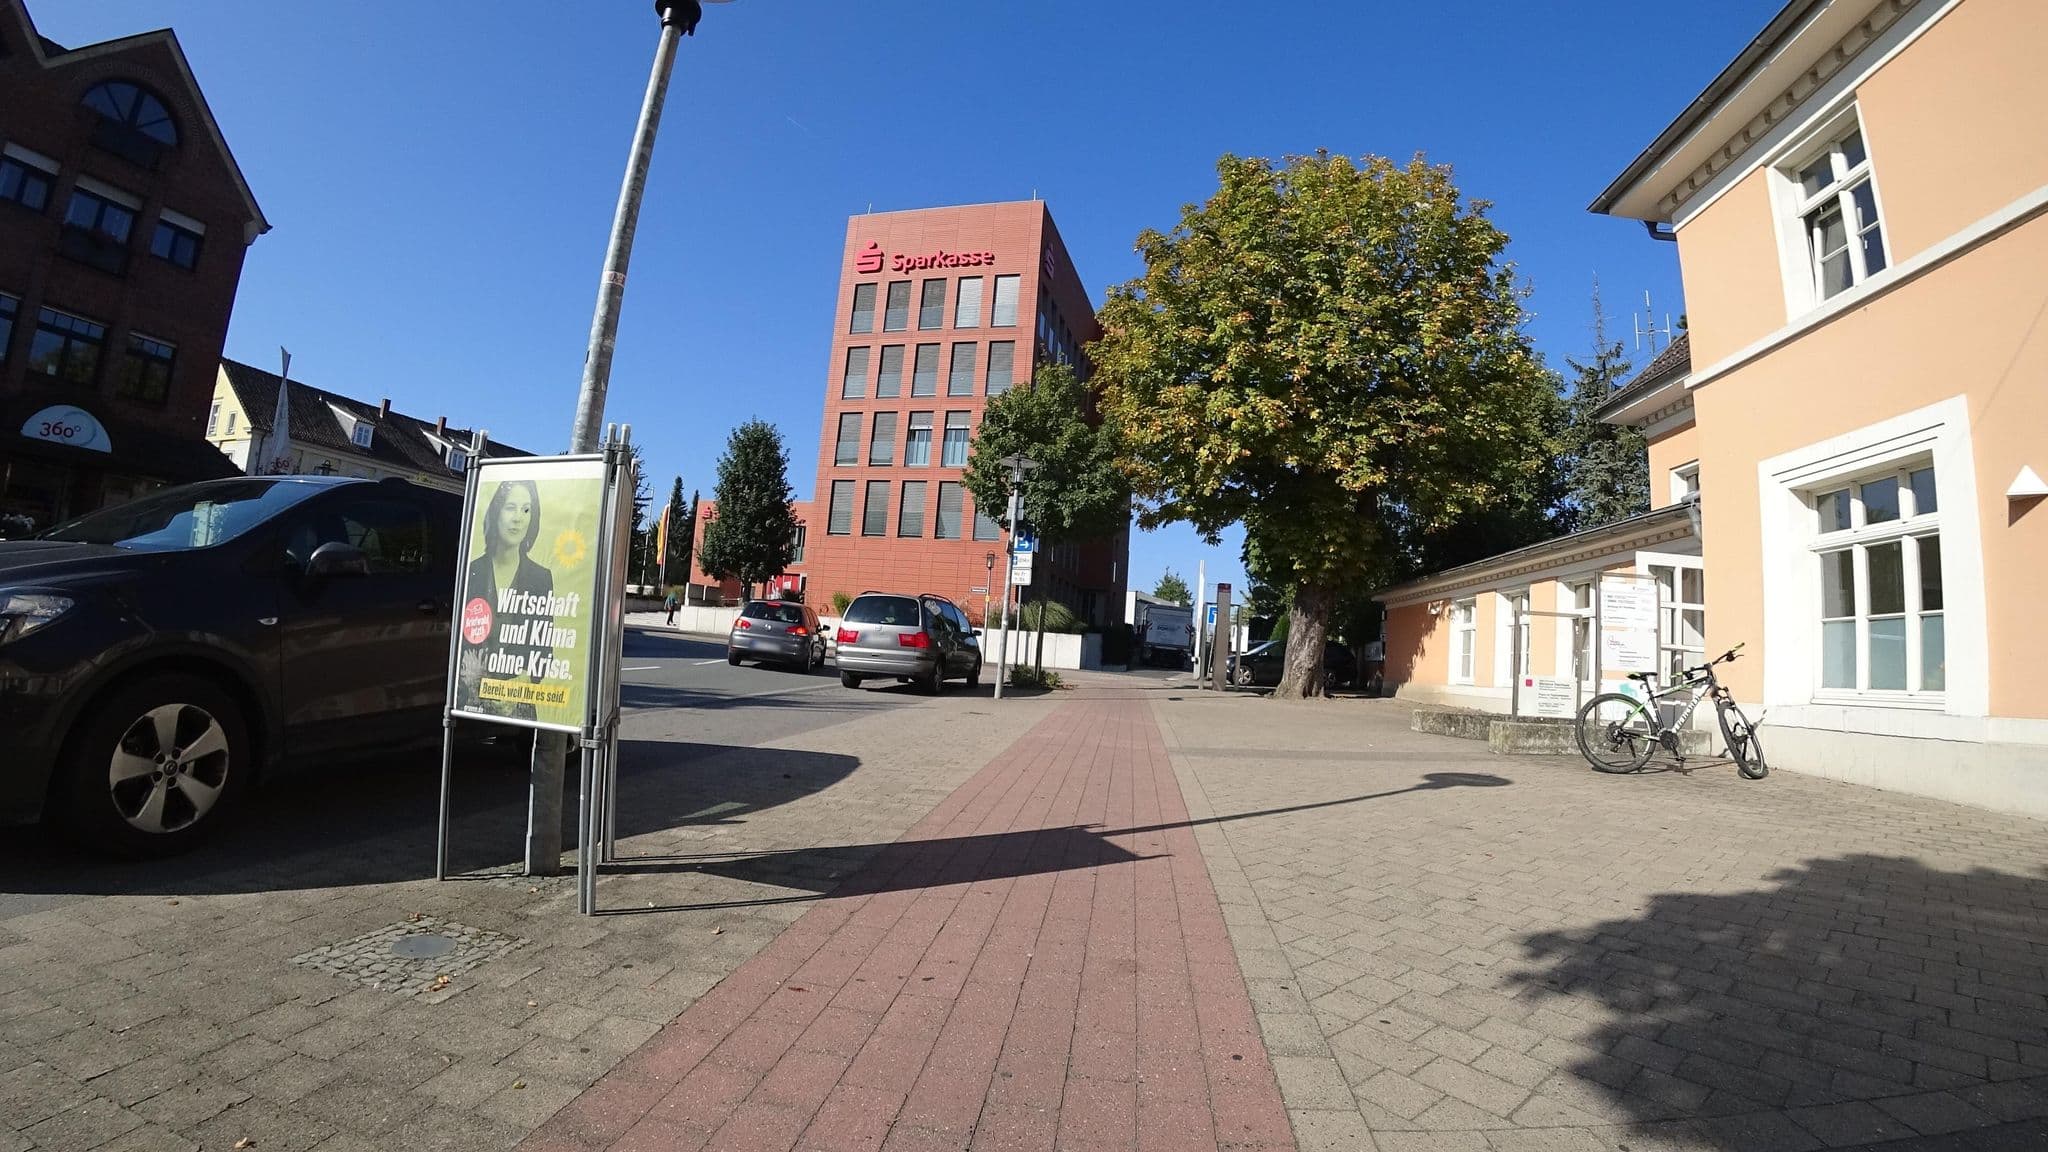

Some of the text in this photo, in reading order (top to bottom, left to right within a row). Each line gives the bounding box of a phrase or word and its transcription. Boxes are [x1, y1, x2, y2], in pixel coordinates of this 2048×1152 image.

[892, 250, 994, 275] Sparkasse
[497, 587, 580, 618] Wirtschaft
[499, 619, 577, 649] und Klima
[488, 648, 573, 680] ohne Krise.
[482, 682, 566, 704] Bereit, weil Ihr es seid.
